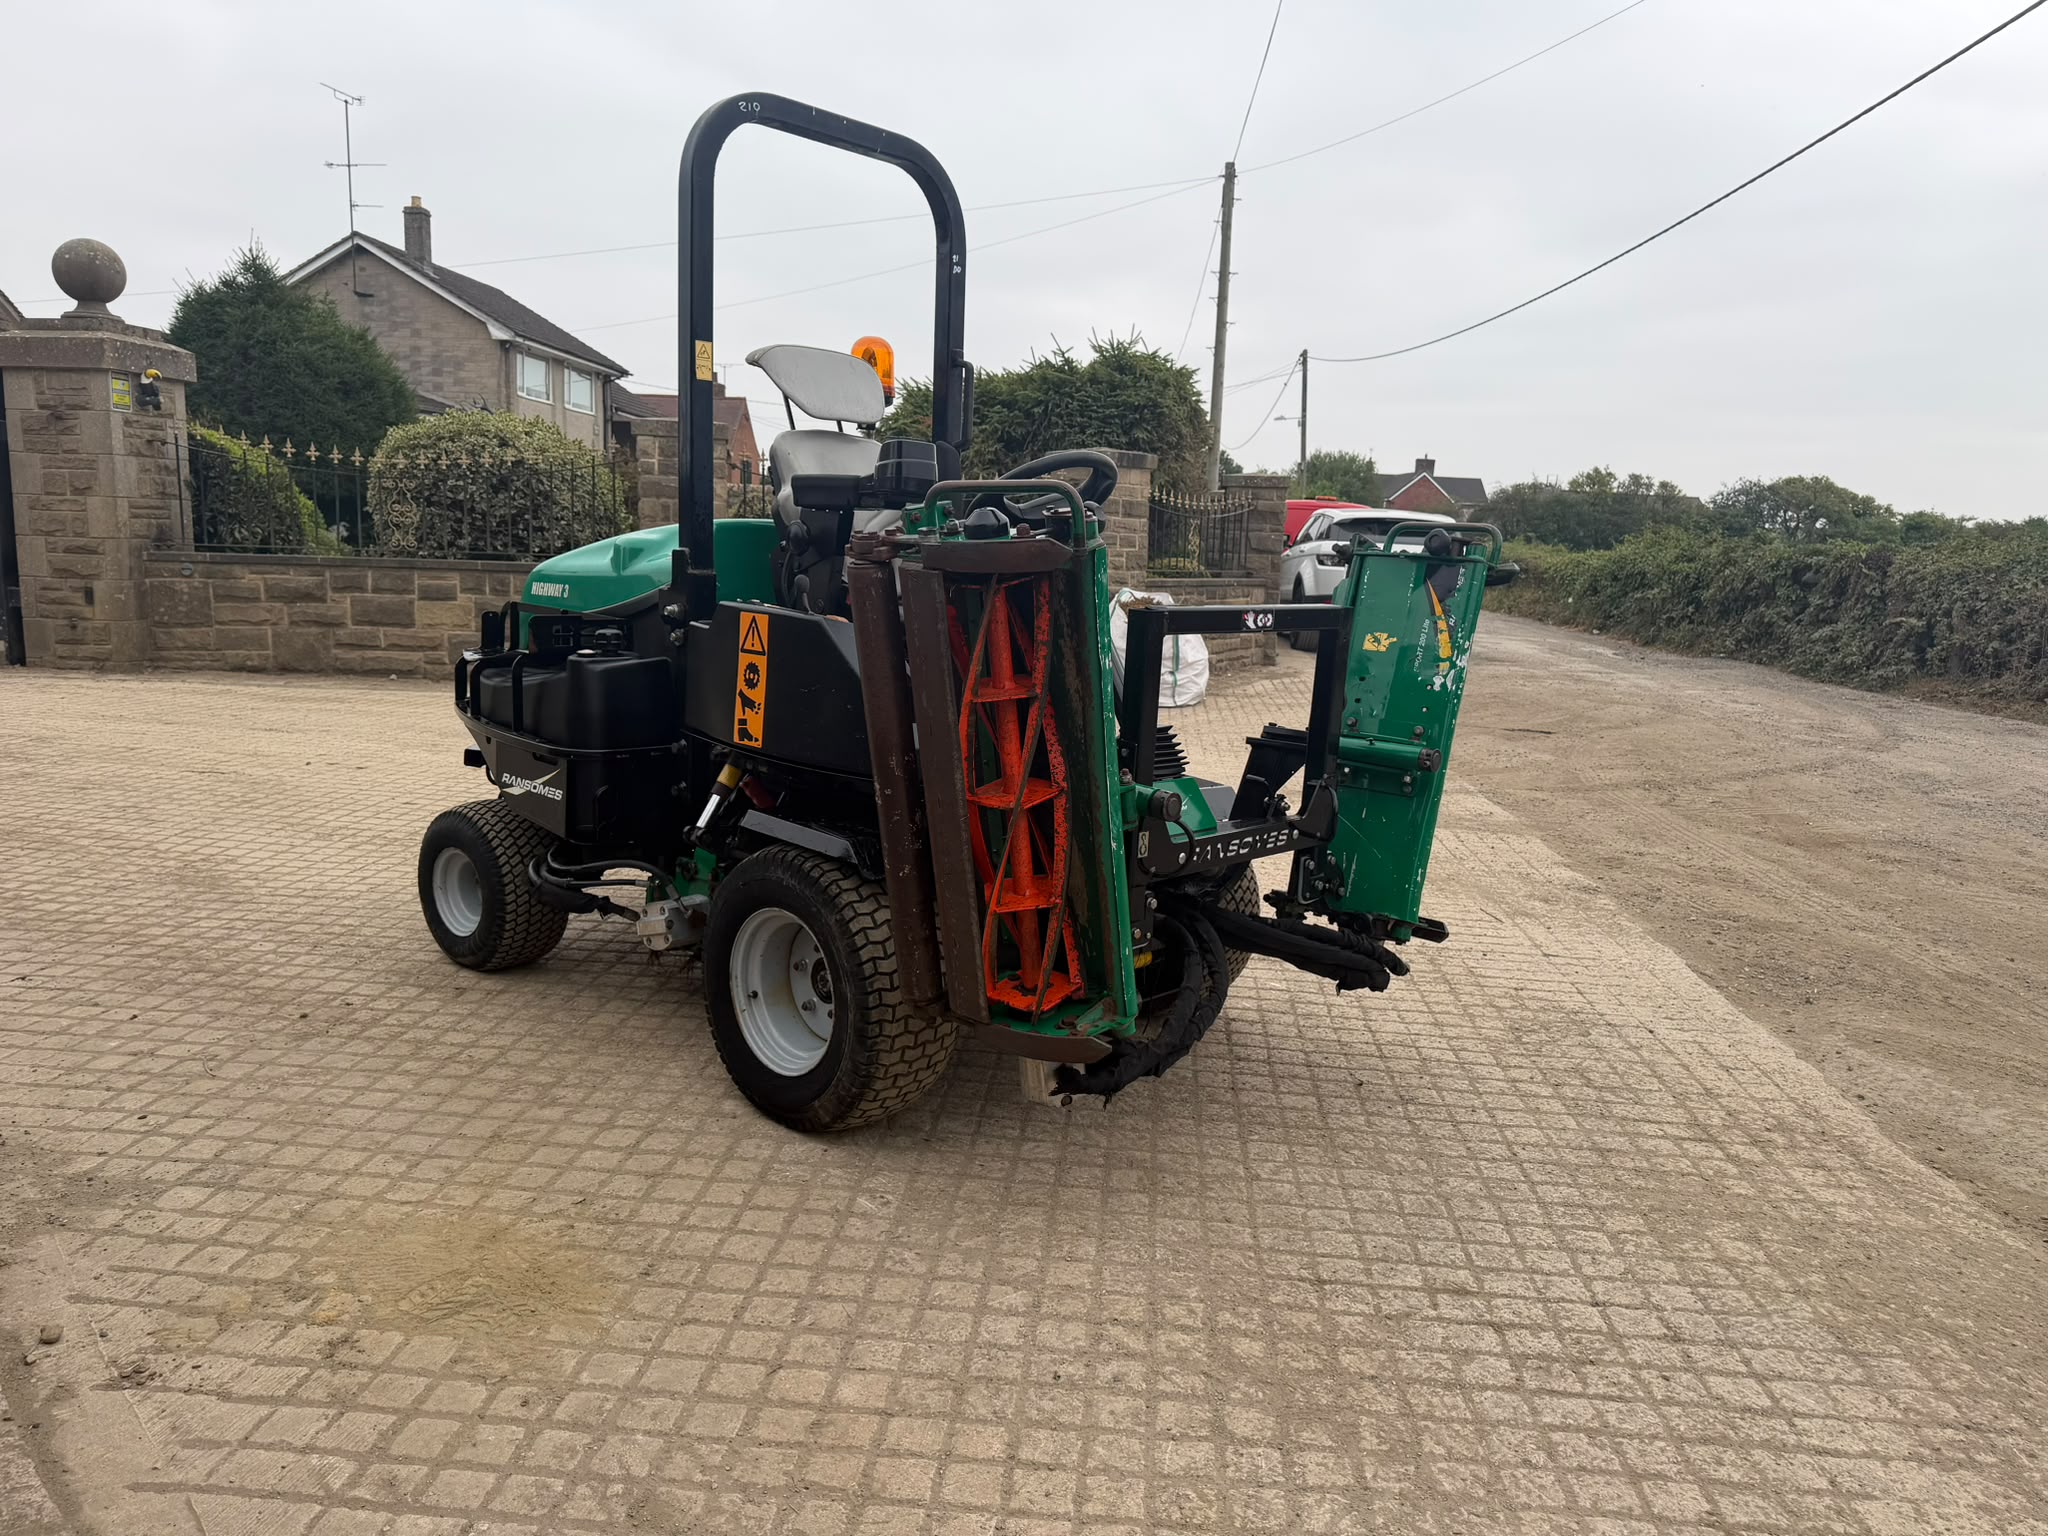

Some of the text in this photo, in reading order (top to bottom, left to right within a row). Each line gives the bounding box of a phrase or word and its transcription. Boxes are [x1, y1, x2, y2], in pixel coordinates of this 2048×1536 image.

[738, 101, 760, 112] 210
[531, 581, 569, 598] HIGHWAY 3
[1418, 630, 1428, 647] 200
[501, 772, 564, 801] RANSOMES
